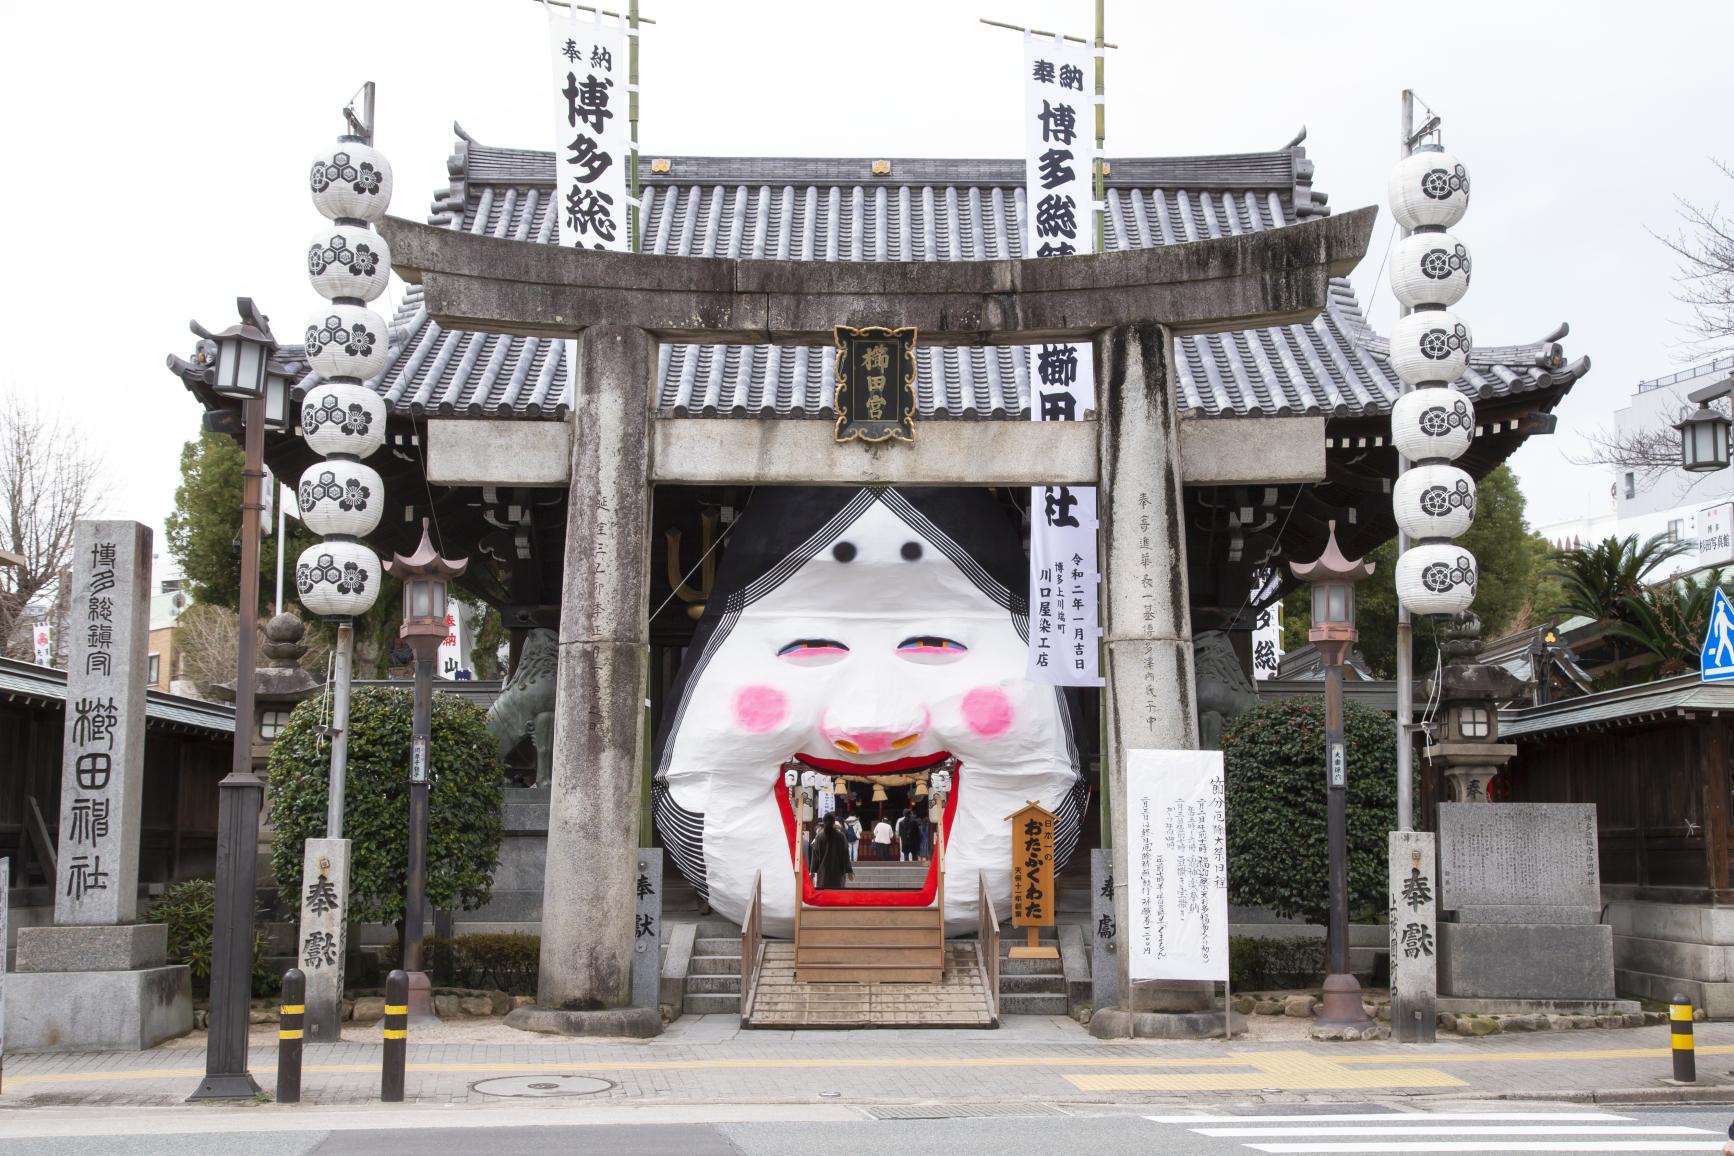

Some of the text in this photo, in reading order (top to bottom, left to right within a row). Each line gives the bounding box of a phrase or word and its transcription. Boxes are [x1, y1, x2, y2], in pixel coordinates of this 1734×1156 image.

[562, 38, 612, 72] 奉納
[1032, 59, 1084, 91] 奉納
[562, 71, 617, 249] 博多総
[862, 344, 890, 420] 櫛田宮
[1036, 568, 1052, 667] 川口屋染工店
[1072, 552, 1085, 670] 令和二年一月吉日
[67, 697, 119, 899] 櫛田神社
[1044, 820, 1053, 861] 日本一の
[1024, 818, 1043, 919] おたふくわた
